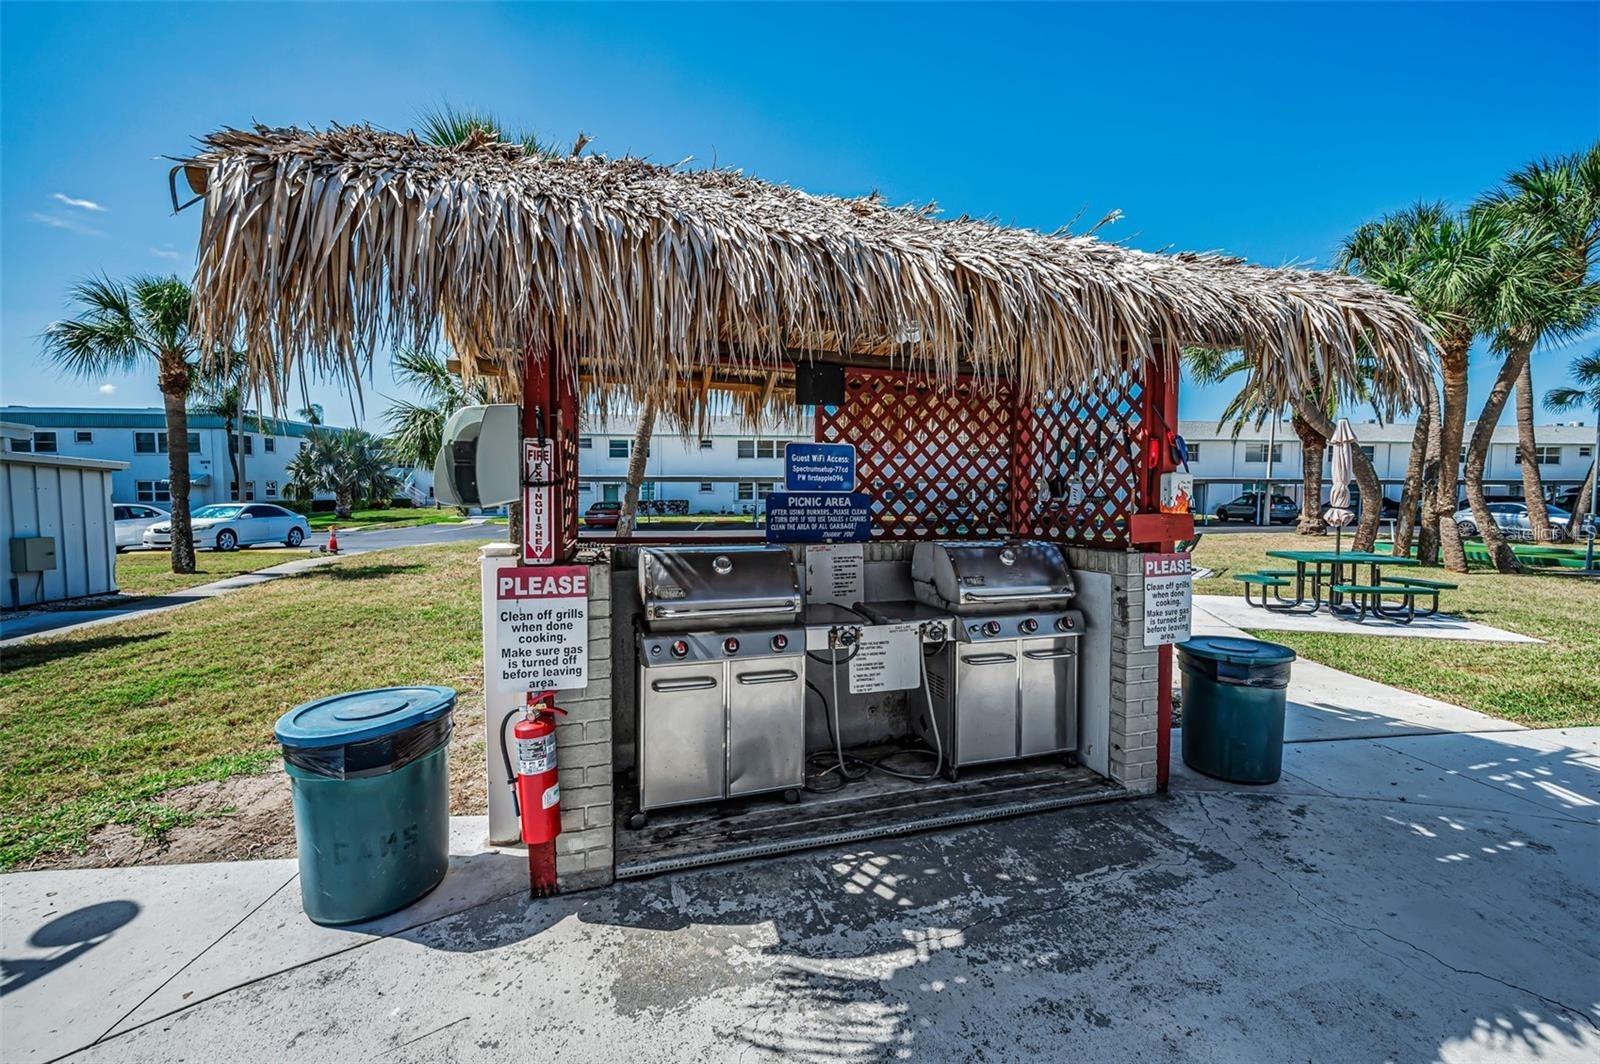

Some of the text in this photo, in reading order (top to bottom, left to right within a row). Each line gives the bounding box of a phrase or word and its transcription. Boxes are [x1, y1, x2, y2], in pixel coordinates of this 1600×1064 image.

[528, 450, 549, 461] FIRE
[791, 454, 849, 463] Guest WiFi Access:
[788, 497, 852, 507] PICNIC AREA
[1145, 559, 1191, 575] PLEASE
[499, 576, 586, 596] PLEASE
[1146, 581, 1190, 592] Clean off grills
[1152, 590, 1169, 599] when
[1155, 598, 1181, 607] cooking.
[500, 609, 584, 622] Clean off grills
[1147, 610, 1163, 618] Make
[1164, 609, 1178, 617] sure
[1150, 618, 1156, 626] is
[1157, 616, 1177, 625] turned
[511, 621, 573, 633] when done
[1147, 623, 1189, 634] before leaving
[518, 632, 567, 644] cooking.
[501, 646, 583, 658] Make sure gas
[508, 655, 577, 669] is turned off
[502, 666, 582, 680] before leaving
[529, 679, 557, 689] area.
